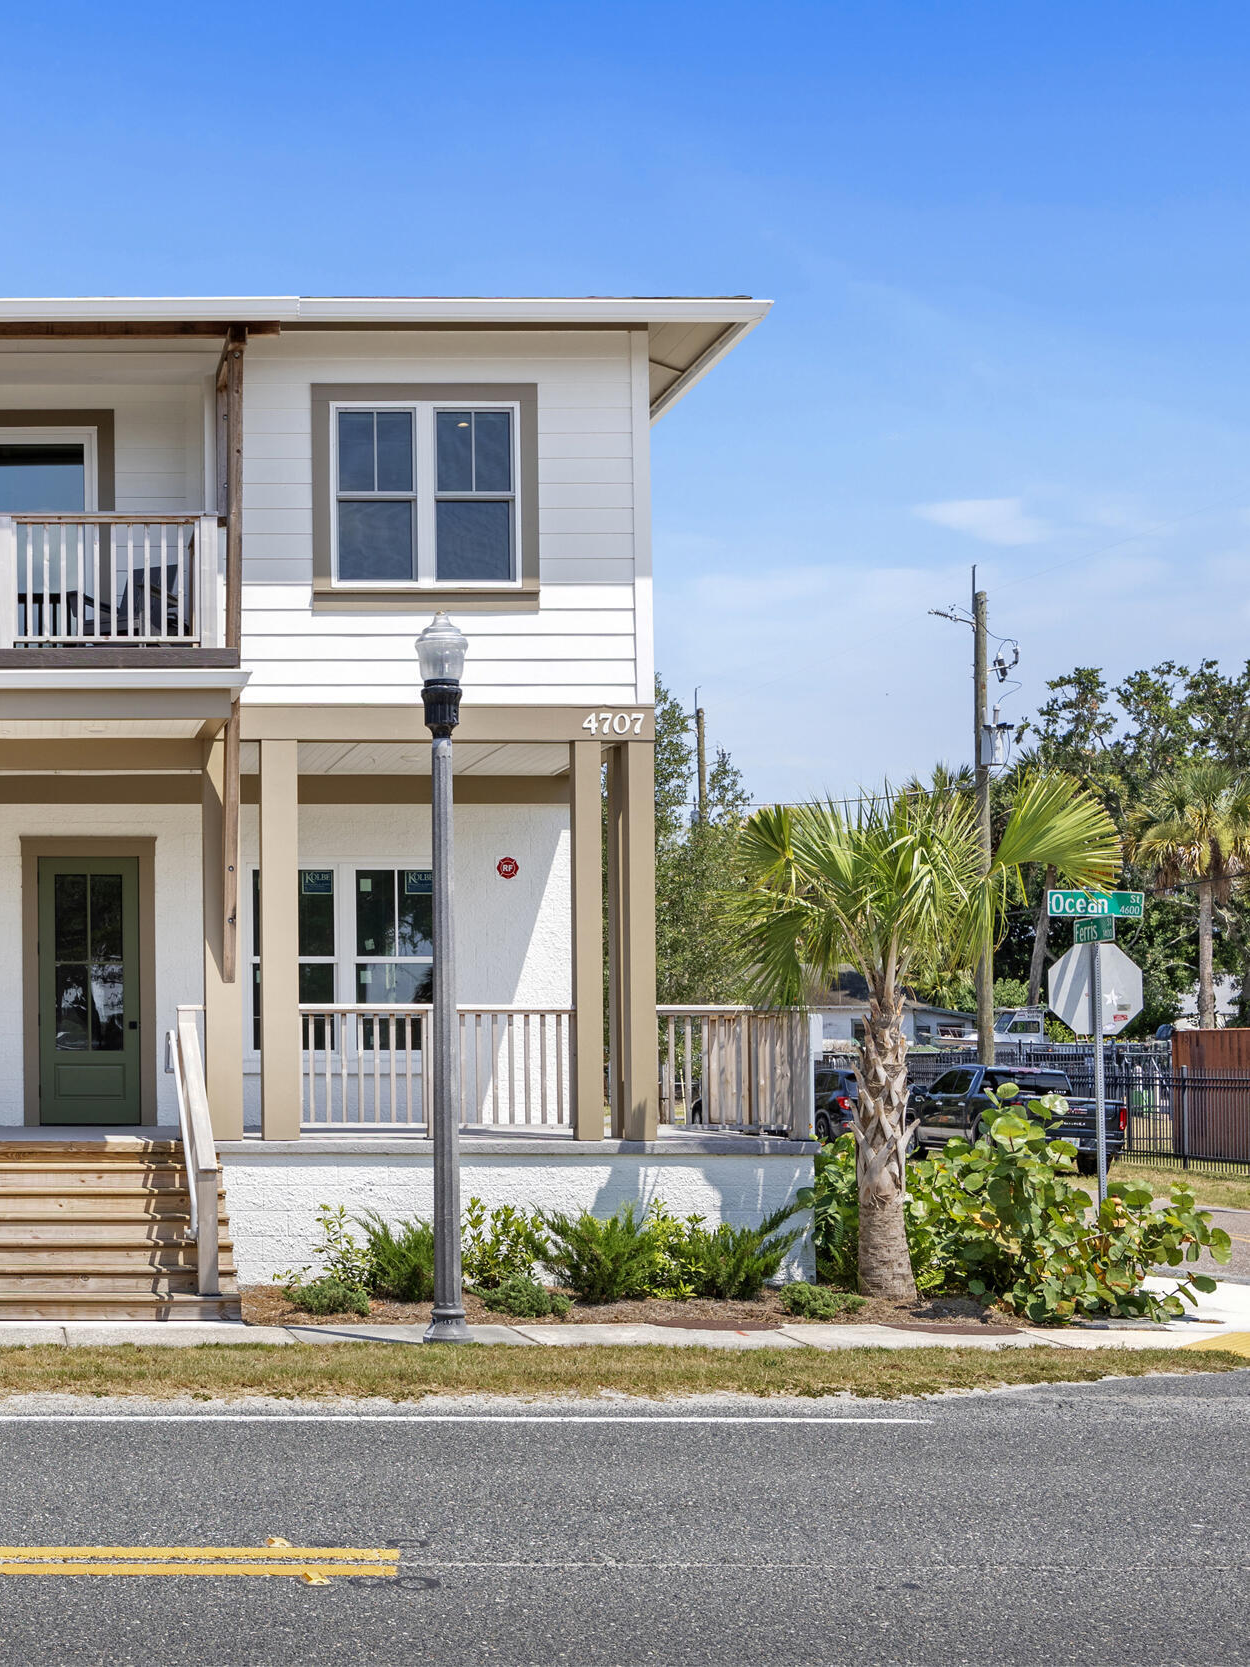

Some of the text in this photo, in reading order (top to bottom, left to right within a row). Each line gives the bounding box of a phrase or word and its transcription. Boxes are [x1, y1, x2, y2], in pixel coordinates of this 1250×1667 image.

[582, 713, 645, 735] 4707
[502, 864, 513, 872] RF
[1051, 893, 1140, 914] Ocean St
[1119, 905, 1140, 914] 4600
[1075, 923, 1098, 942] Ferris
